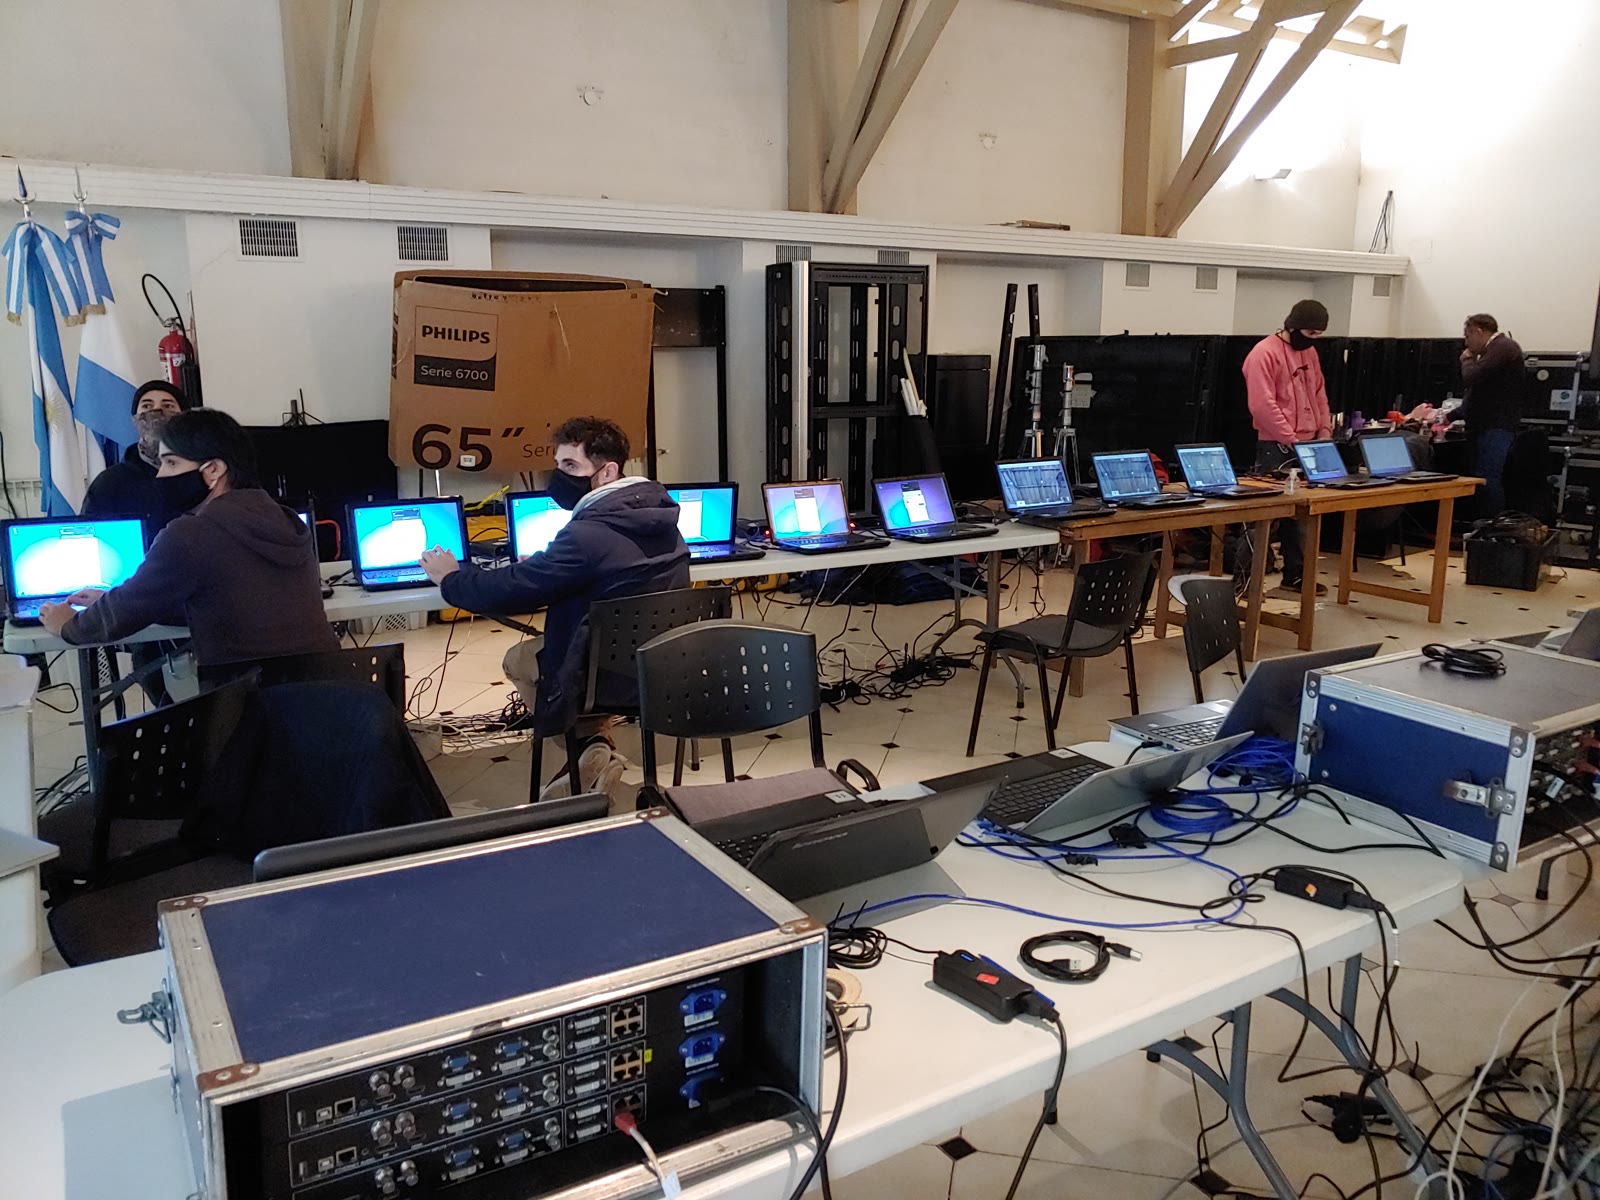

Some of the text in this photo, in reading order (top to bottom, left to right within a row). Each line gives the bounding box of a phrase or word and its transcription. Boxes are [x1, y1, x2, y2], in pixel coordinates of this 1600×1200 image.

[422, 325, 490, 344] PHILIPS
[421, 365, 489, 381] Serie 6700
